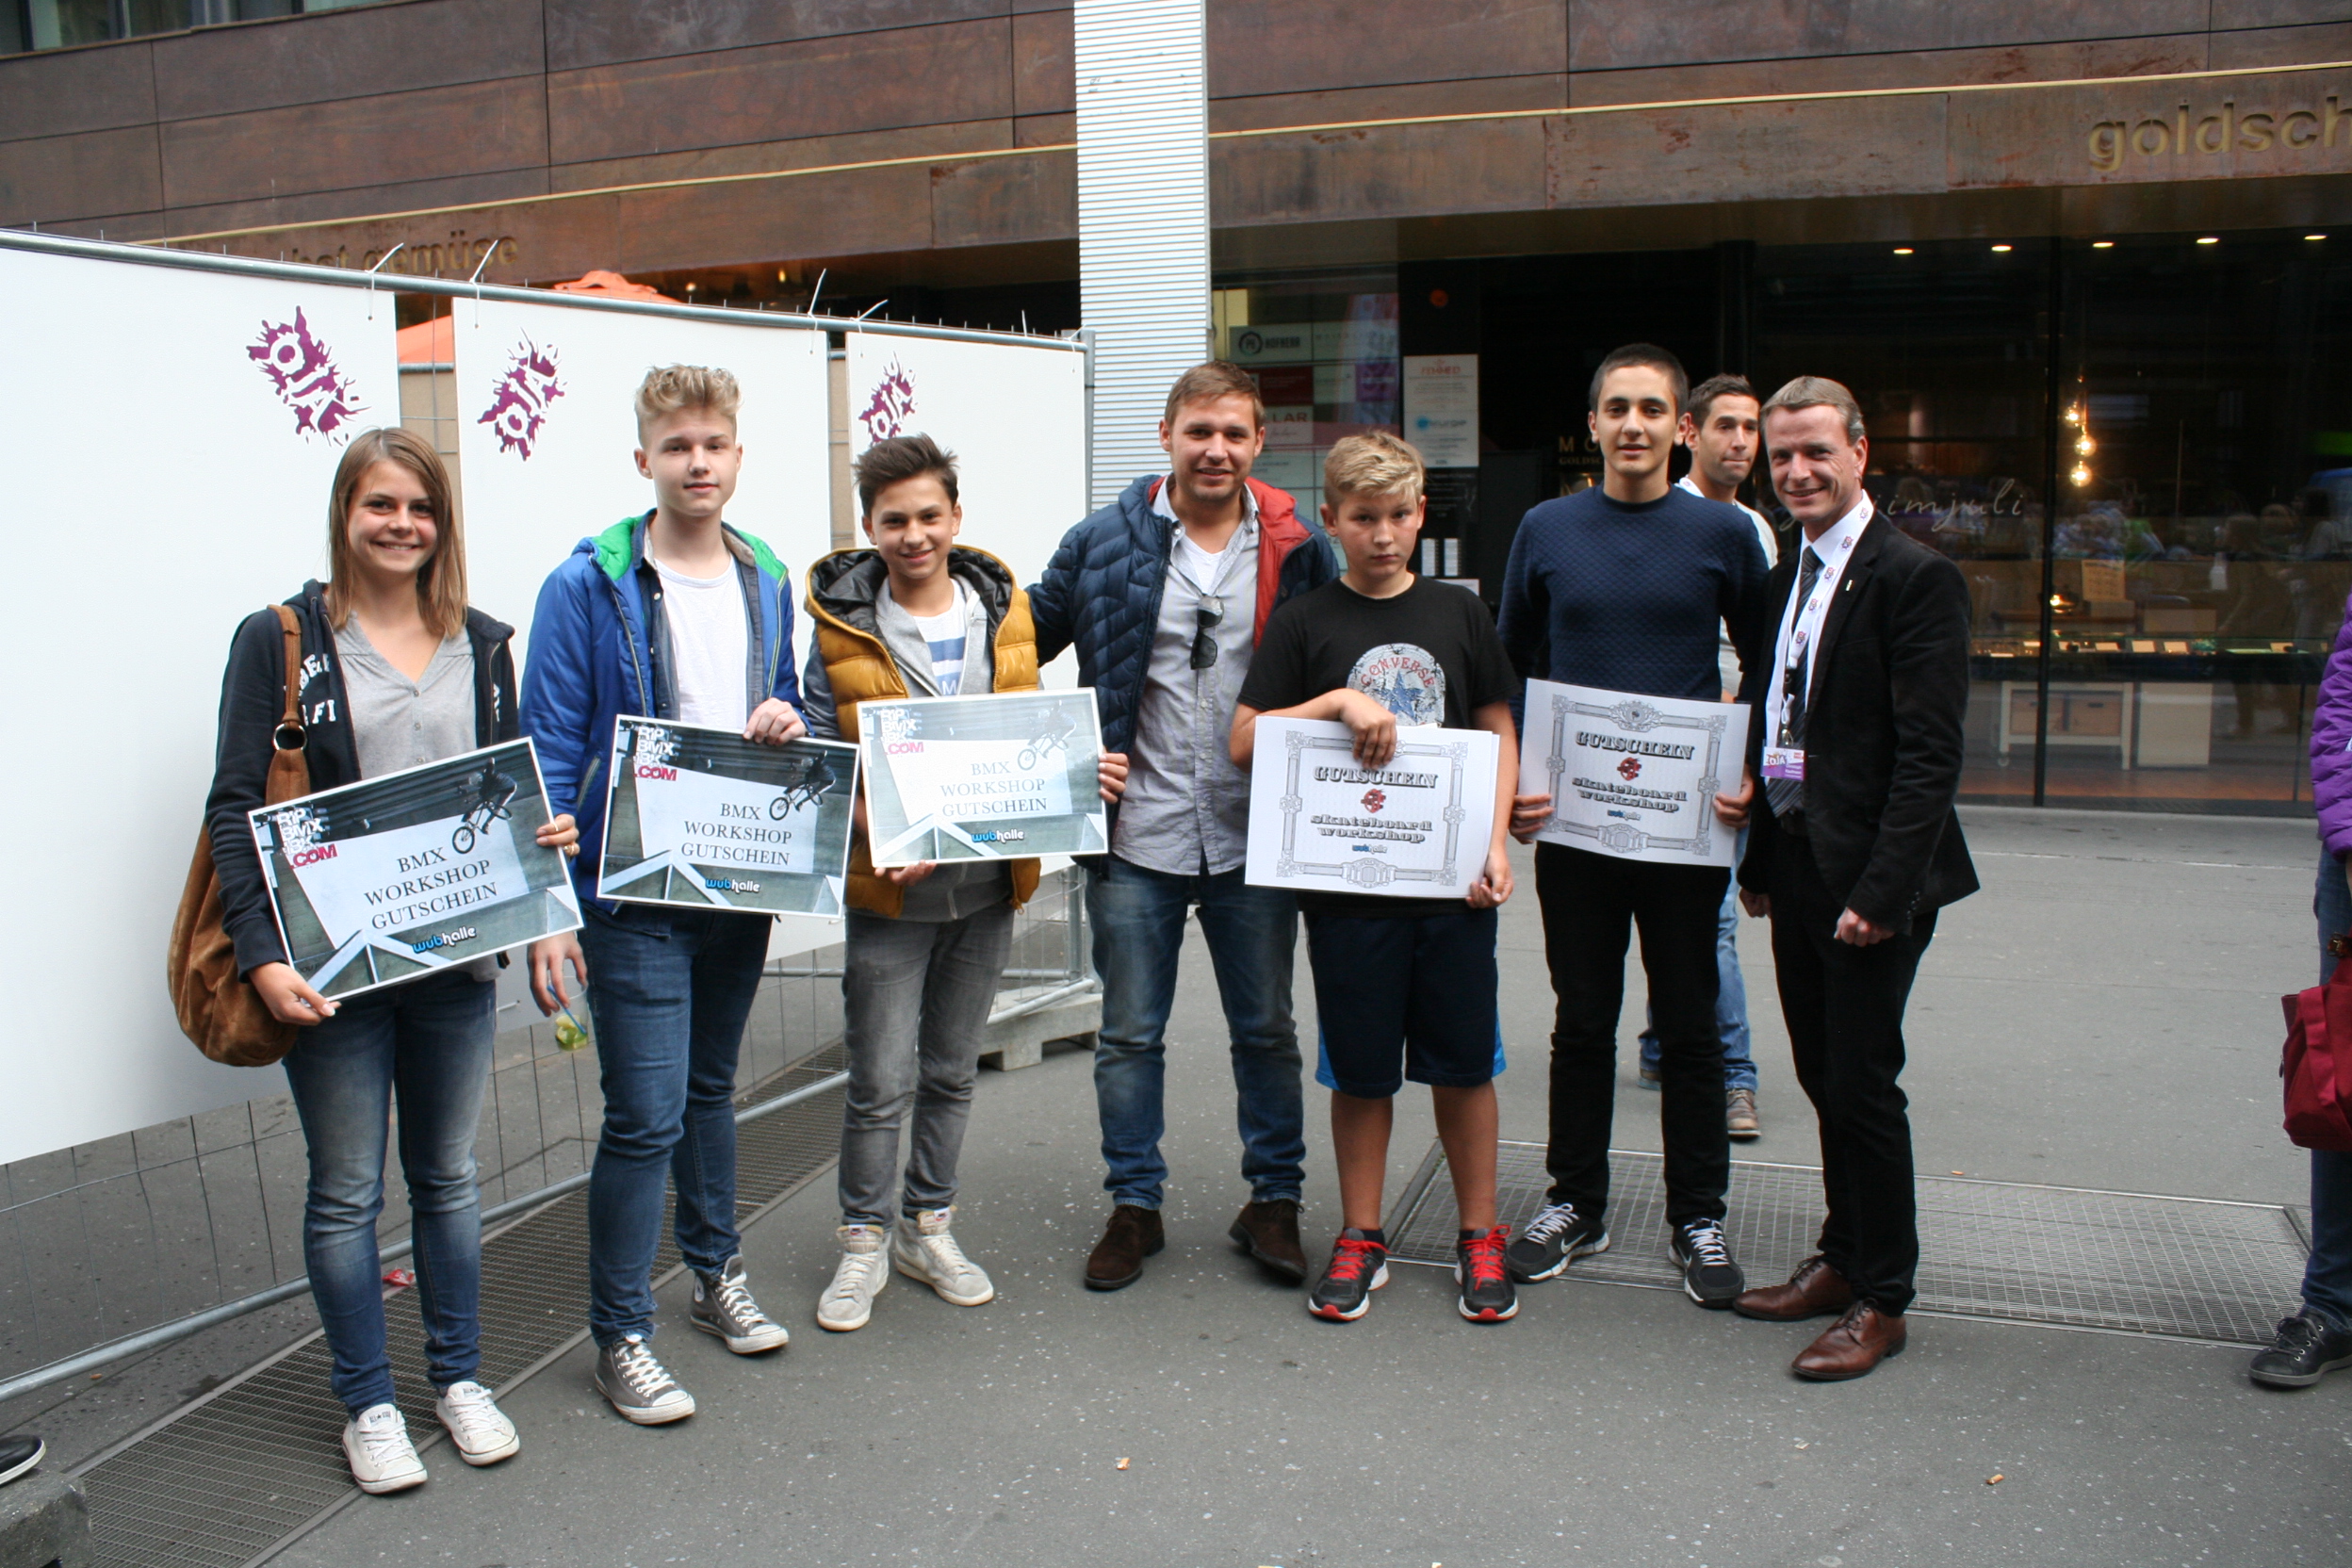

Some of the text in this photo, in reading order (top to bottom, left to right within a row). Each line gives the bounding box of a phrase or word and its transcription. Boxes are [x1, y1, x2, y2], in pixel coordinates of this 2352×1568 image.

[363, 230, 518, 274] gemüse
[1360, 657, 1436, 689] CONVERSE
[637, 740, 675, 756] BMX
[1576, 731, 1694, 760] GUTSCHEIN
[971, 760, 1012, 776] BMX
[1313, 766, 1438, 789] GUTSCHEIN
[939, 778, 1045, 797] WORKSHOP
[1572, 777, 1687, 801] skateboard
[720, 803, 761, 821] BMX
[942, 797, 1047, 817] GUTSCHEIN
[1576, 790, 1679, 813] workshop
[281, 818, 325, 841] BMX
[684, 821, 792, 844] WORKSHOP
[1311, 814, 1432, 831] skateboard
[972, 829, 1025, 843] wubhalle
[1317, 827, 1425, 843] workshop
[398, 847, 447, 873] BMX
[681, 843, 790, 866] GUTSCHEIN
[364, 859, 491, 906] WORKSHOP
[706, 877, 760, 893] wubhalle
[371, 882, 498, 929] GUTSCHEIN
[413, 926, 477, 954] wubhalle
